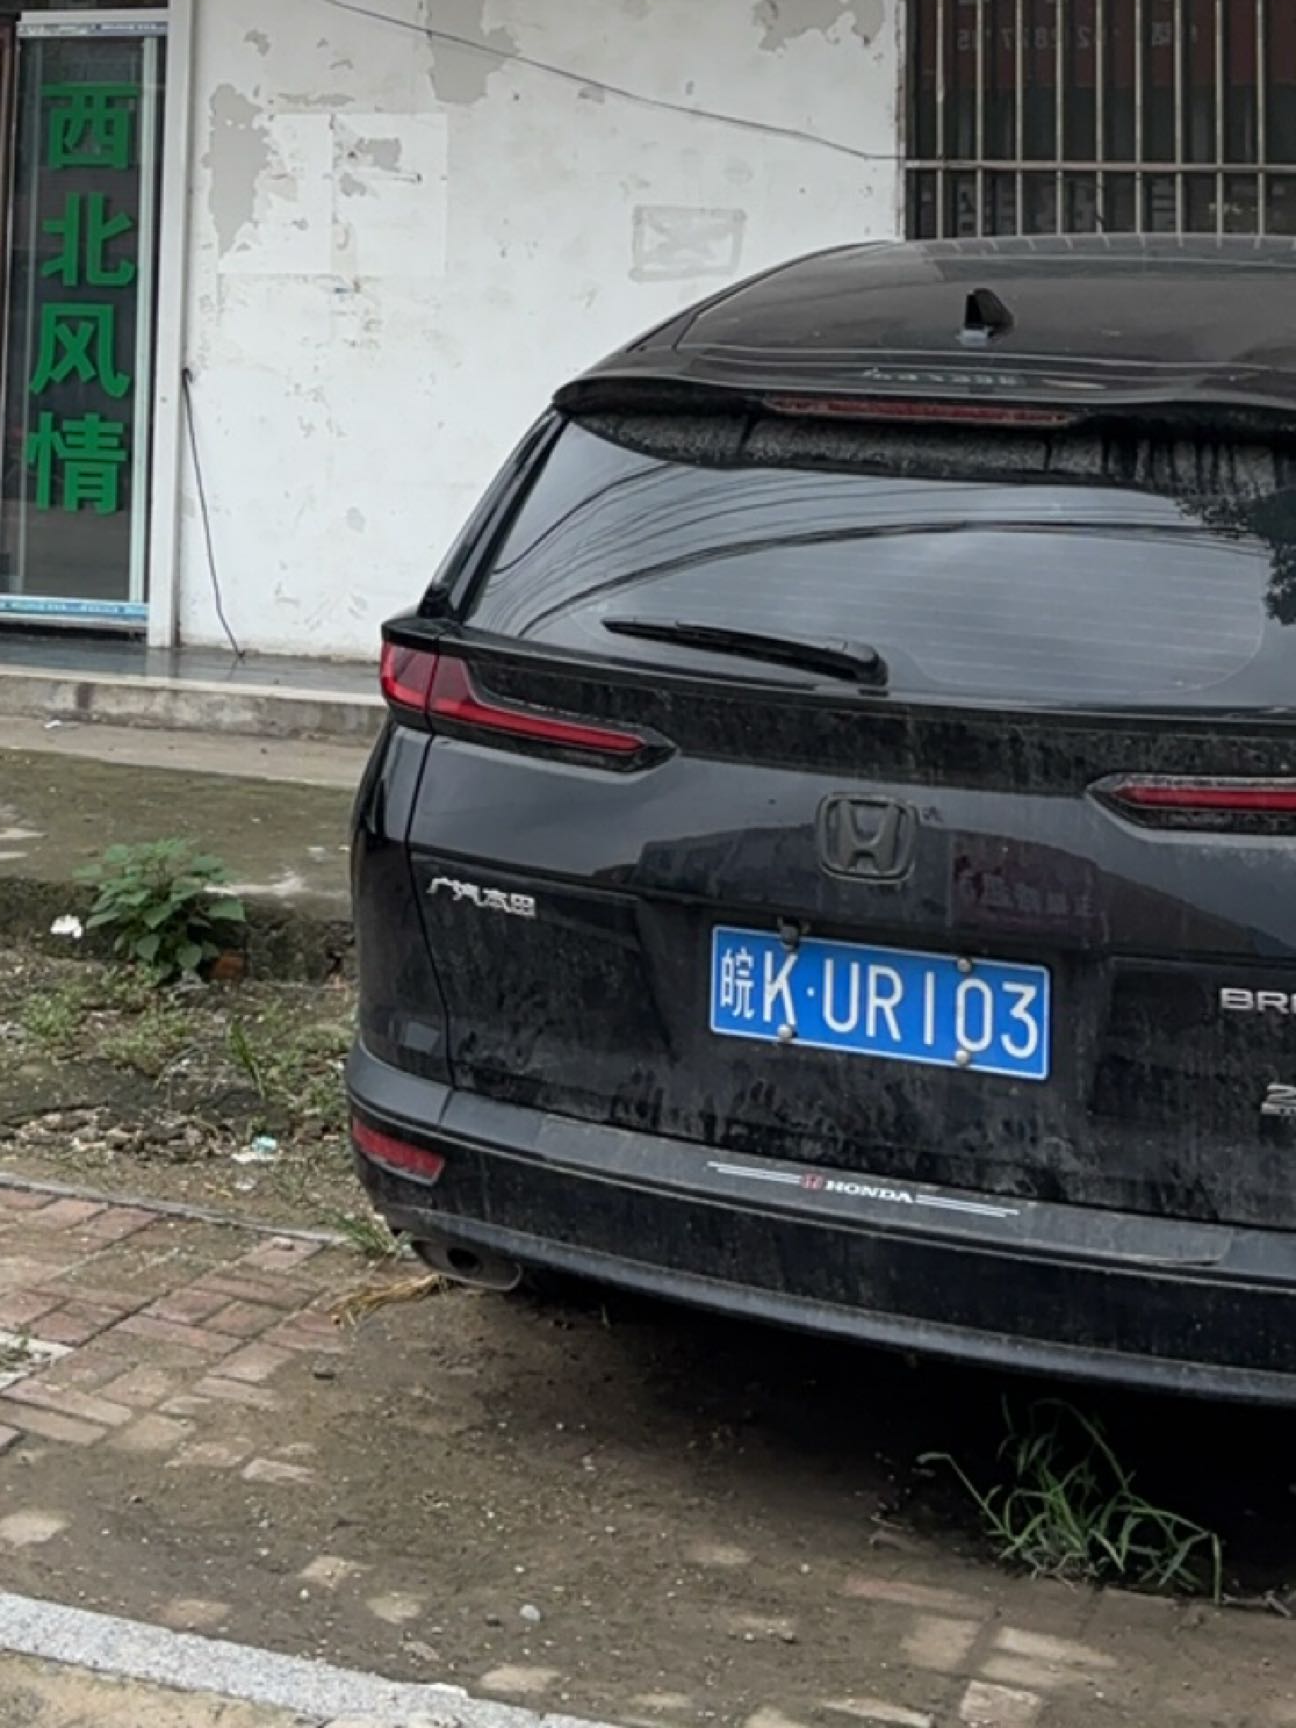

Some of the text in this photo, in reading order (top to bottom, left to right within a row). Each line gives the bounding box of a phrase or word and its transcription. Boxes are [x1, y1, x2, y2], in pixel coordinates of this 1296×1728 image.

[27, 82, 141, 514] 西北风情
[1220, 986, 1296, 1015] BR
[824, 1179, 914, 1204] HONDA
